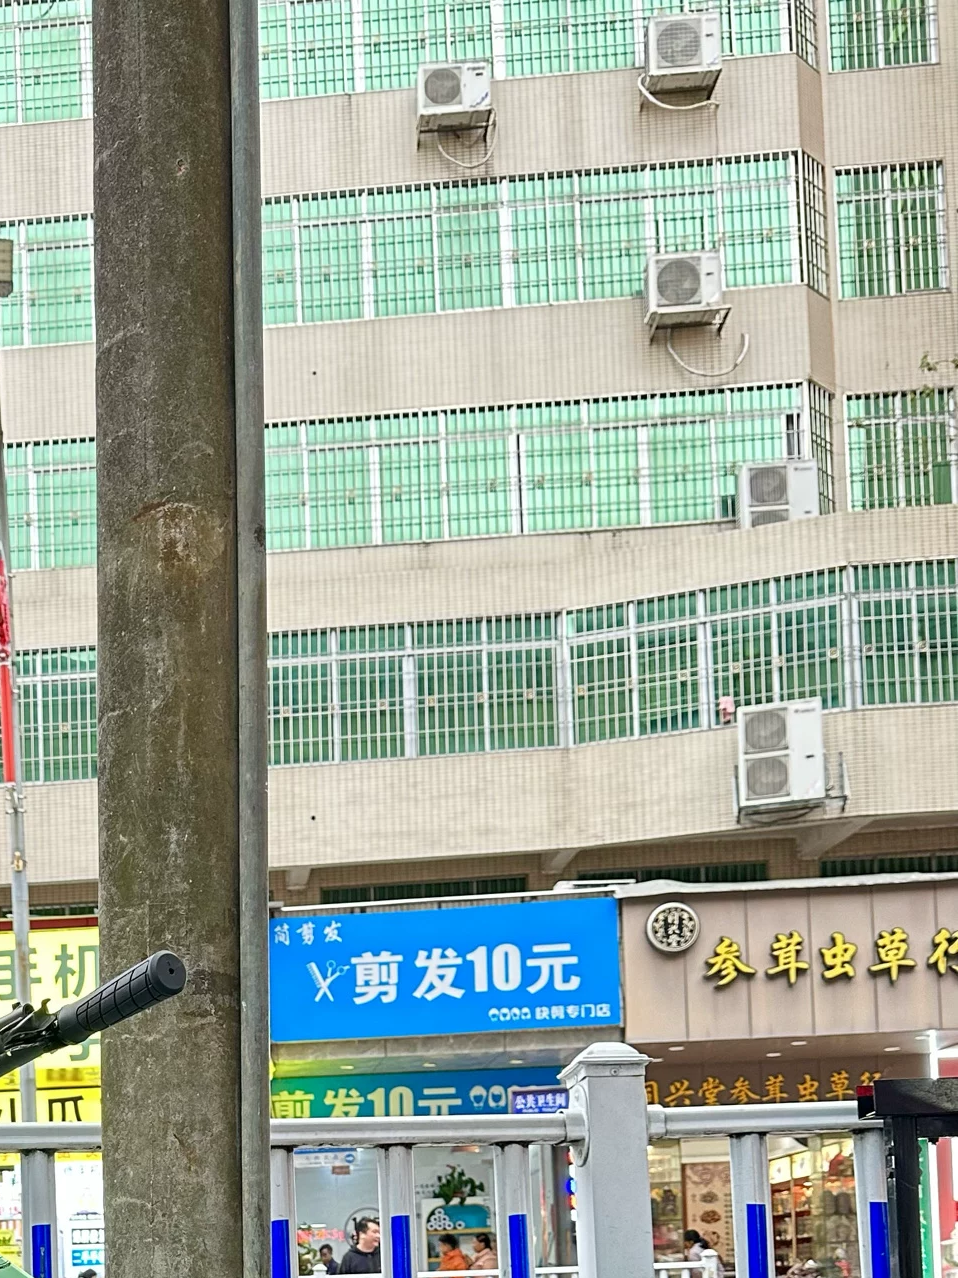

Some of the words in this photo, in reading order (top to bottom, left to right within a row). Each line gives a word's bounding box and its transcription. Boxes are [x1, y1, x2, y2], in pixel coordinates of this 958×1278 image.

[351, 943, 581, 1005] 剪发10元
[704, 927, 958, 988] 参茸虫草行
